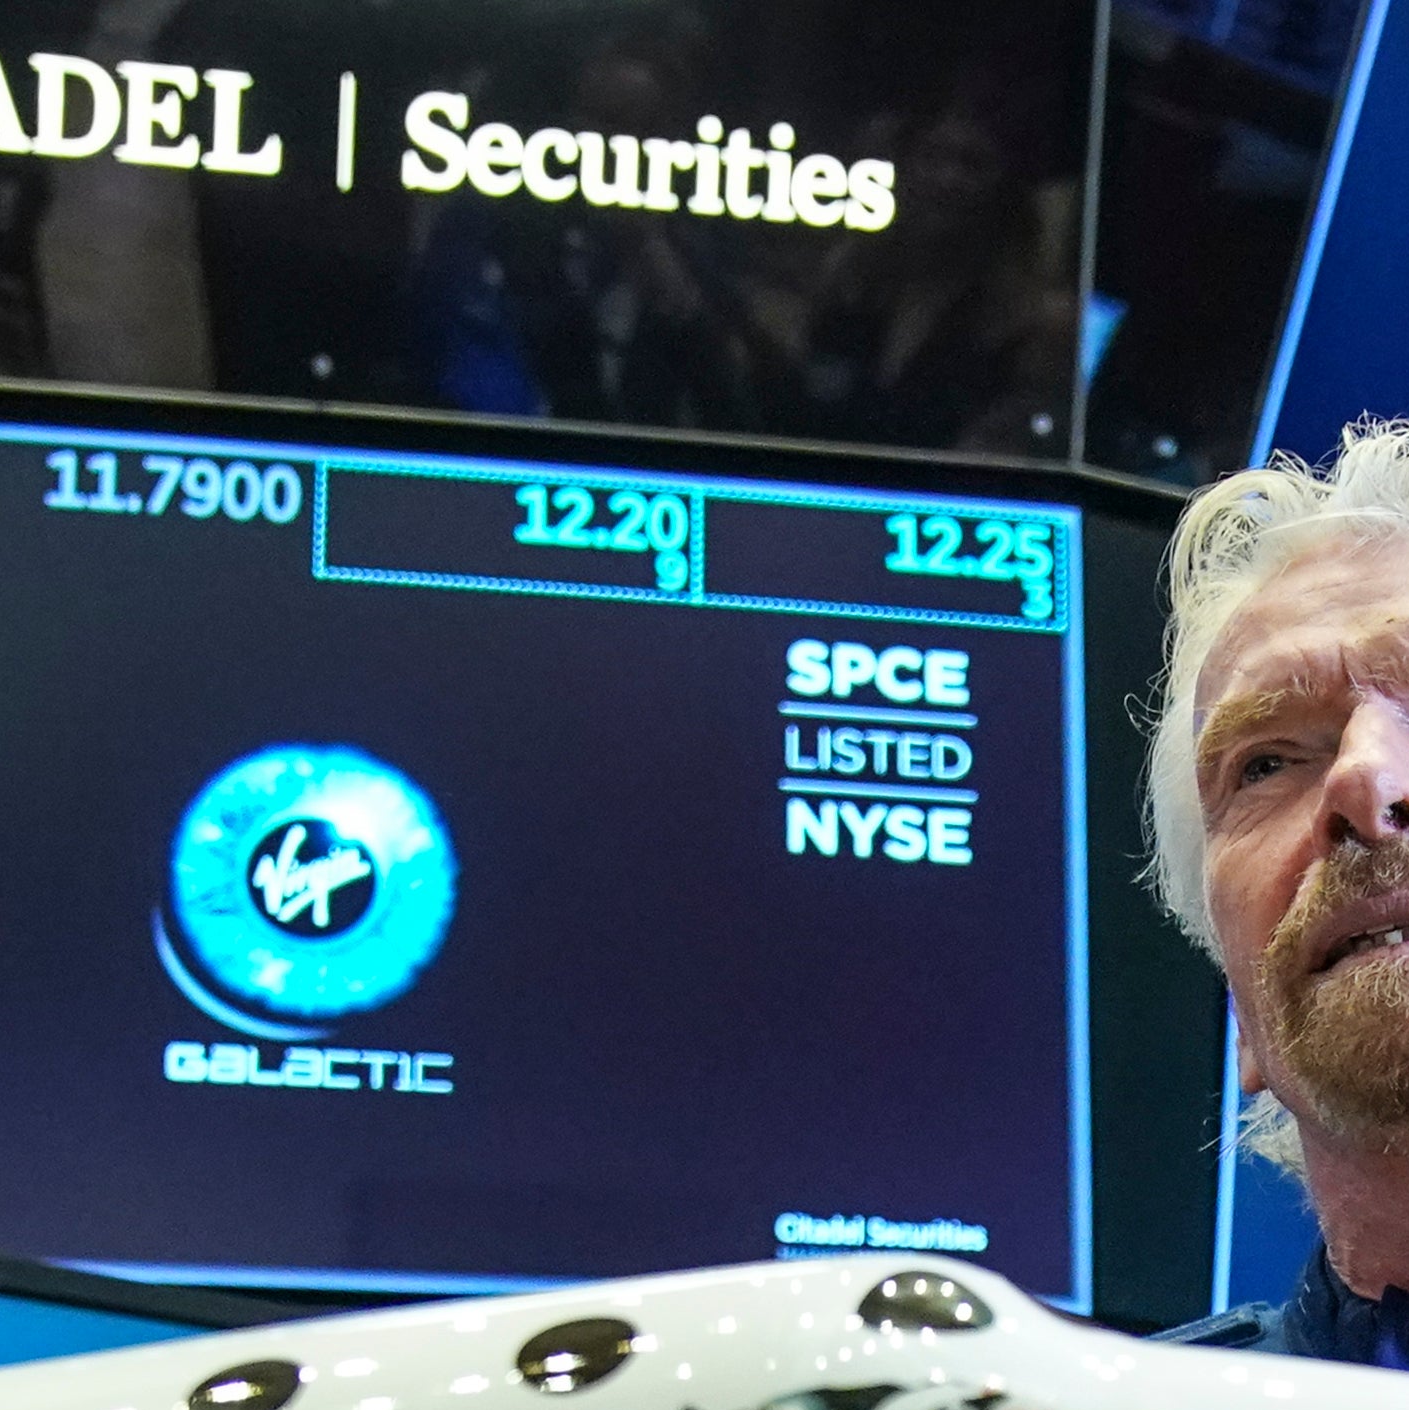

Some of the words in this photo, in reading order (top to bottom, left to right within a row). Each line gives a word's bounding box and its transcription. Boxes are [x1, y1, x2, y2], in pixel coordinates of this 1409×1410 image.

[401, 91, 896, 231] Securities
[45, 451, 302, 524] 11.7900
[514, 484, 688, 552] 12.20
[885, 514, 1053, 580] 12.25
[786, 638, 970, 704] SPCE
[784, 725, 972, 781] LISTED
[787, 799, 973, 864] NYSE
[774, 1212, 865, 1247] Citadel
[866, 1216, 988, 1252] Securities
